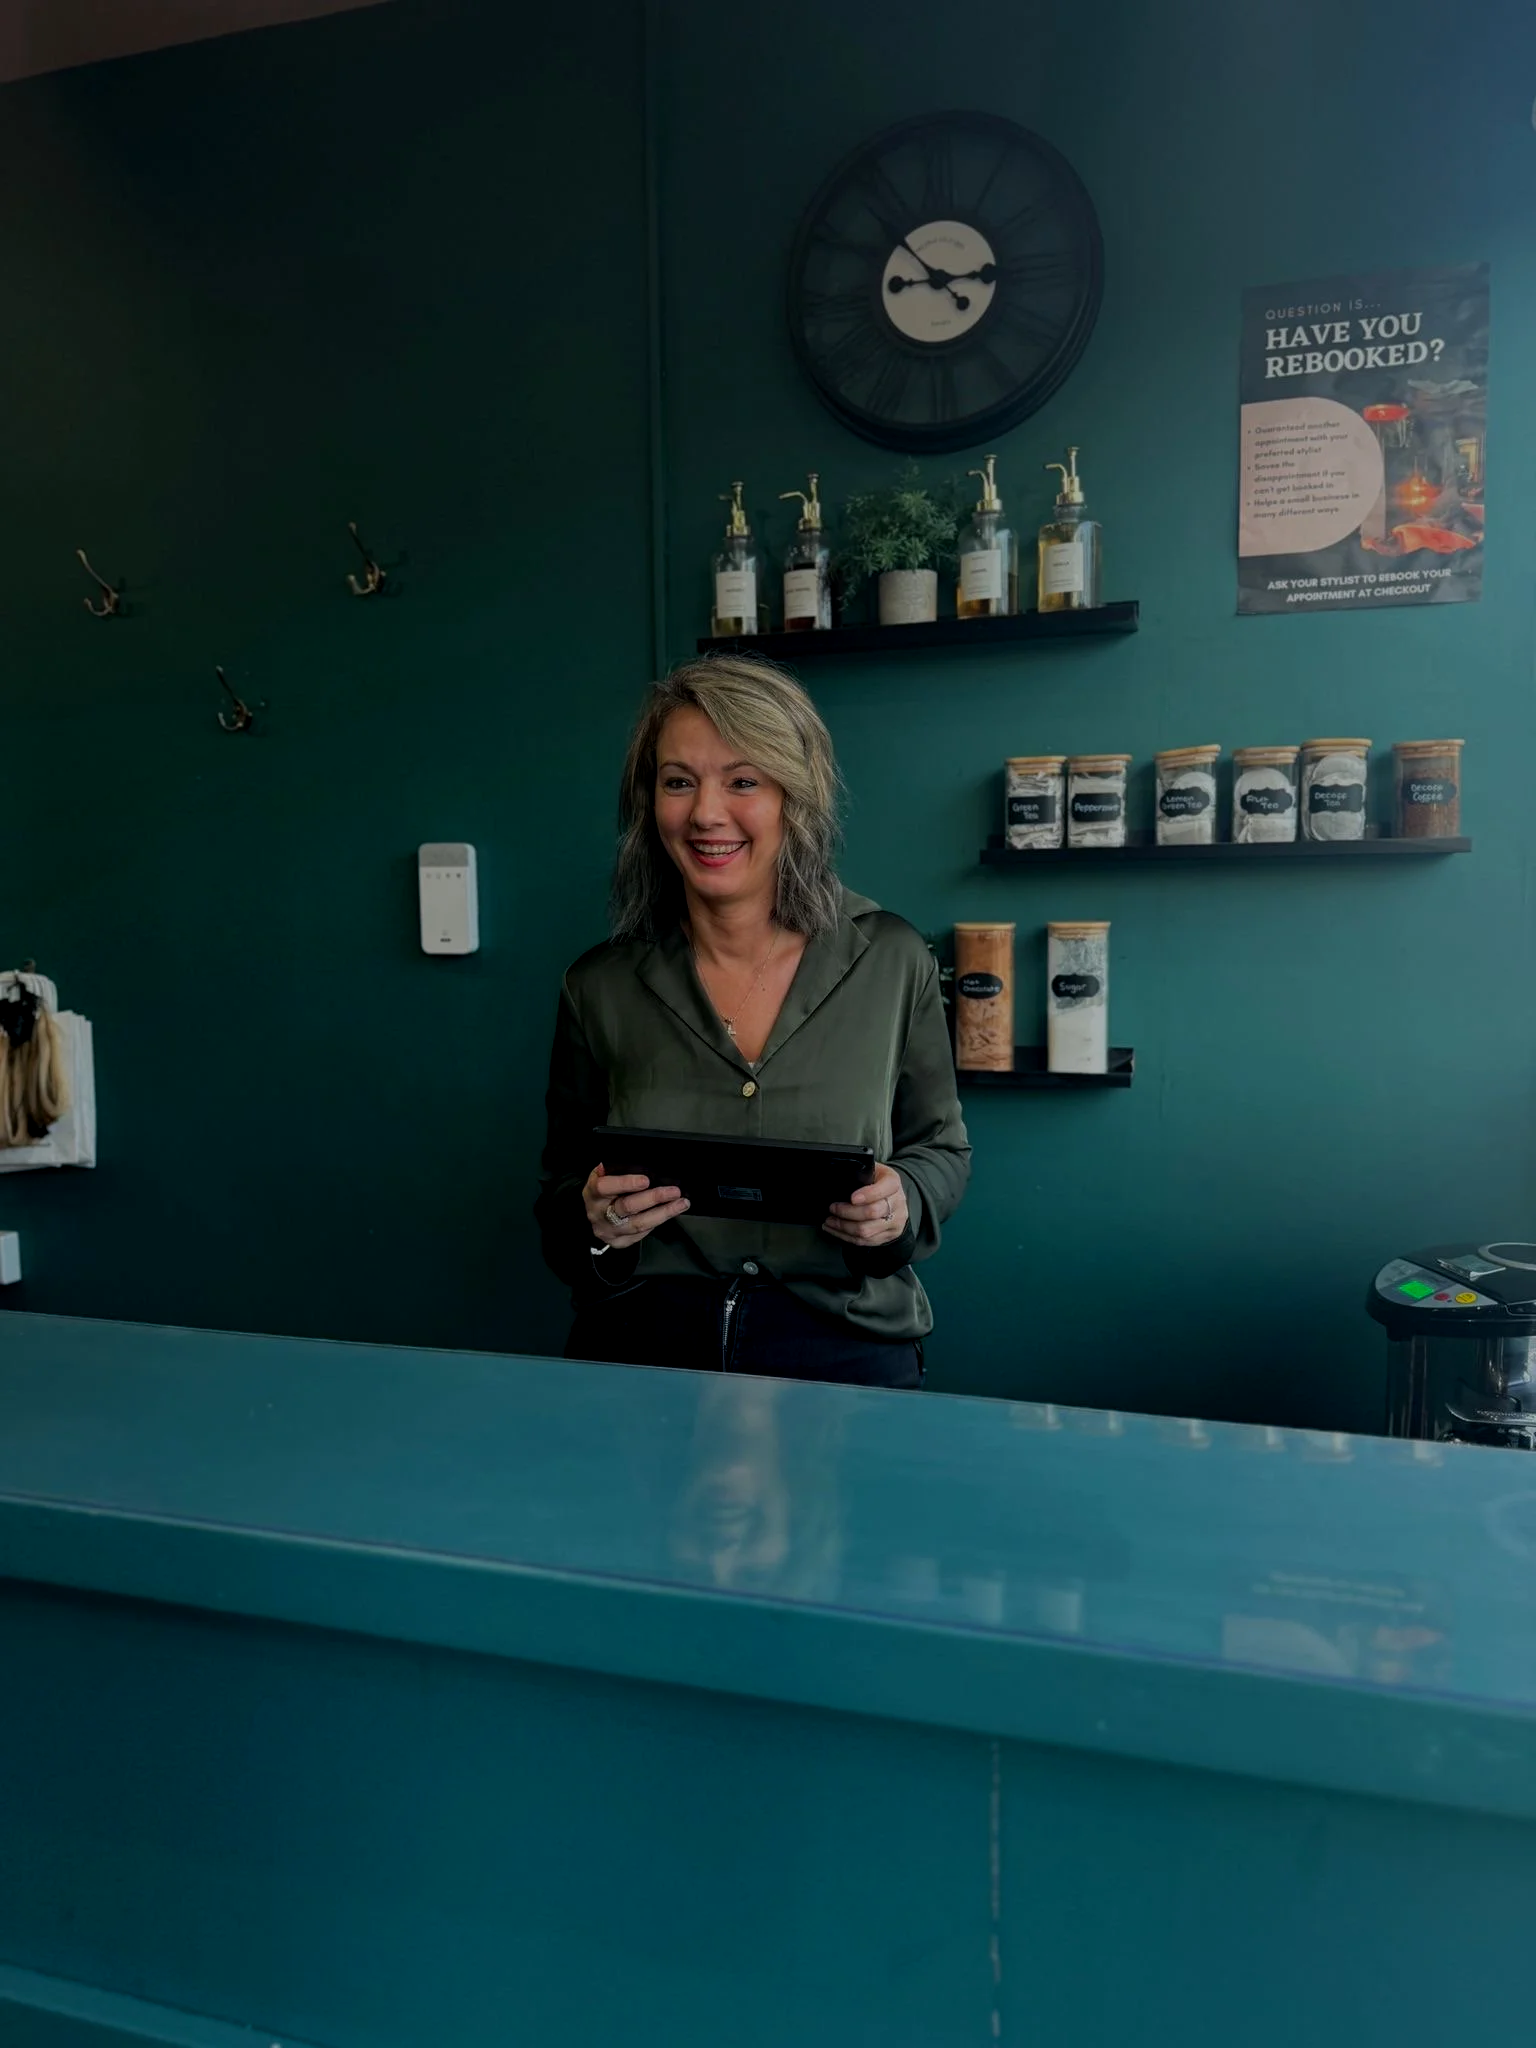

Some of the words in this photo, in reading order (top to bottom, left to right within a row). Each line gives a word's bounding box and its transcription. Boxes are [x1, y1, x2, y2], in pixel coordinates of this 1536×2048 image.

[1265, 302, 1341, 320] QUESTION
[1265, 322, 1350, 350] HAVE
[1359, 312, 1423, 340] YOU
[1265, 338, 1445, 379] REBOOKED?
[1307, 422, 1340, 430] another
[1254, 436, 1308, 447] appointment
[1330, 433, 1348, 442] your
[1254, 448, 1294, 459] preferred
[1296, 446, 1322, 456] stylist
[1282, 460, 1295, 468] the
[1254, 472, 1320, 483] disappointment
[1330, 471, 1346, 479] you
[1254, 486, 1274, 495] can't
[1276, 486, 1290, 494] get
[1292, 482, 1324, 491] booked
[1254, 498, 1277, 508] Helps
[1288, 494, 1310, 504] small
[1312, 492, 1350, 502] business
[1254, 510, 1276, 519] many
[1278, 506, 1316, 517] different
[1317, 506, 1340, 515] ways
[1267, 580, 1289, 591] ASK
[1291, 578, 1318, 589] YOUR
[1320, 576, 1360, 588] STYLIST
[1363, 574, 1377, 584] TO
[1380, 570, 1421, 582] REBOOK
[1422, 568, 1452, 578] YOUR
[1286, 588, 1356, 603] APPOINTMENT
[1358, 587, 1372, 598] AT
[1374, 583, 1432, 597] CHECKOUT
[1059, 980, 1087, 994] Sugar
